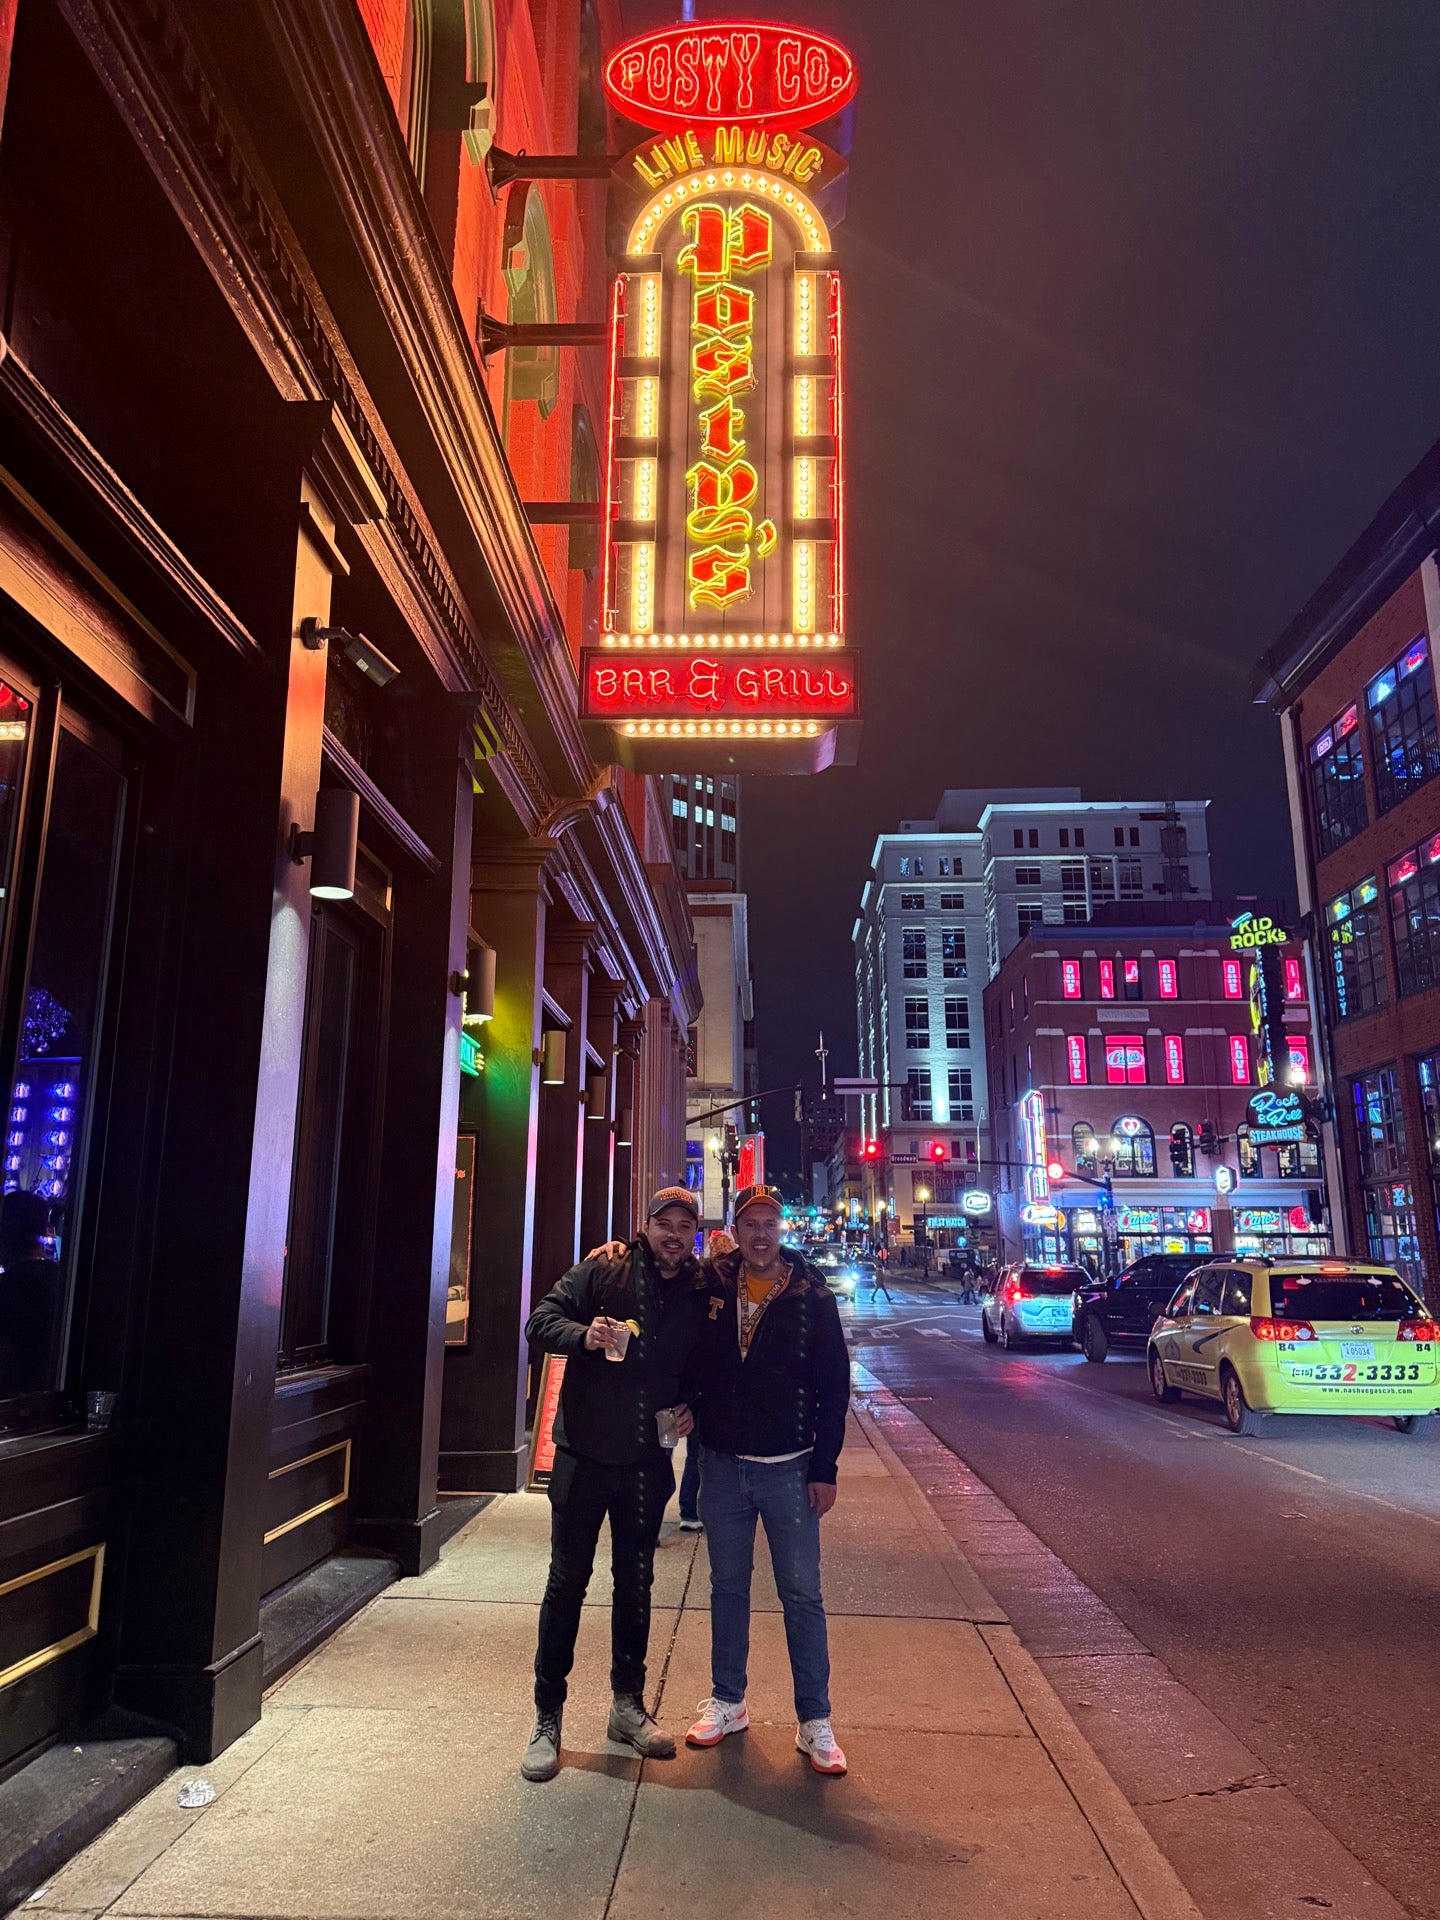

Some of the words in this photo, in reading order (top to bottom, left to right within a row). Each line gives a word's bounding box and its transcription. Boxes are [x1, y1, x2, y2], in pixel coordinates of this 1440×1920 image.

[621, 33, 760, 112] POSTY
[777, 38, 844, 103] CO.
[633, 130, 704, 187] LIVE
[714, 126, 822, 182] MUSIC
[594, 668, 674, 702] BAR
[688, 658, 724, 709] &
[735, 667, 850, 702] GRILL
[1239, 917, 1273, 935] KID
[1065, 964, 1076, 993] ONE
[1162, 964, 1172, 993] ONE
[1227, 964, 1238, 993] ONE
[1071, 1040, 1082, 1079] LOVE
[1168, 1039, 1180, 1079] LOVE
[1234, 1039, 1246, 1080] LOVE
[1250, 1091, 1300, 1113] Rock
[1266, 1108, 1303, 1127] Roll
[1249, 1125, 1305, 1145] STEAKHOUSE
[927, 1217, 946, 1229] FIRST
[946, 1217, 967, 1229] WATCH
[1118, 1210, 1157, 1230] Cane's
[1239, 1210, 1277, 1230] Cane's
[709, 1296, 724, 1321] T
[1278, 1343, 1296, 1352] 84
[1416, 1343, 1431, 1352] 84
[1314, 1363, 1420, 1382] 332-3333
[1321, 1386, 1413, 1395] www.nashvegascab.com
